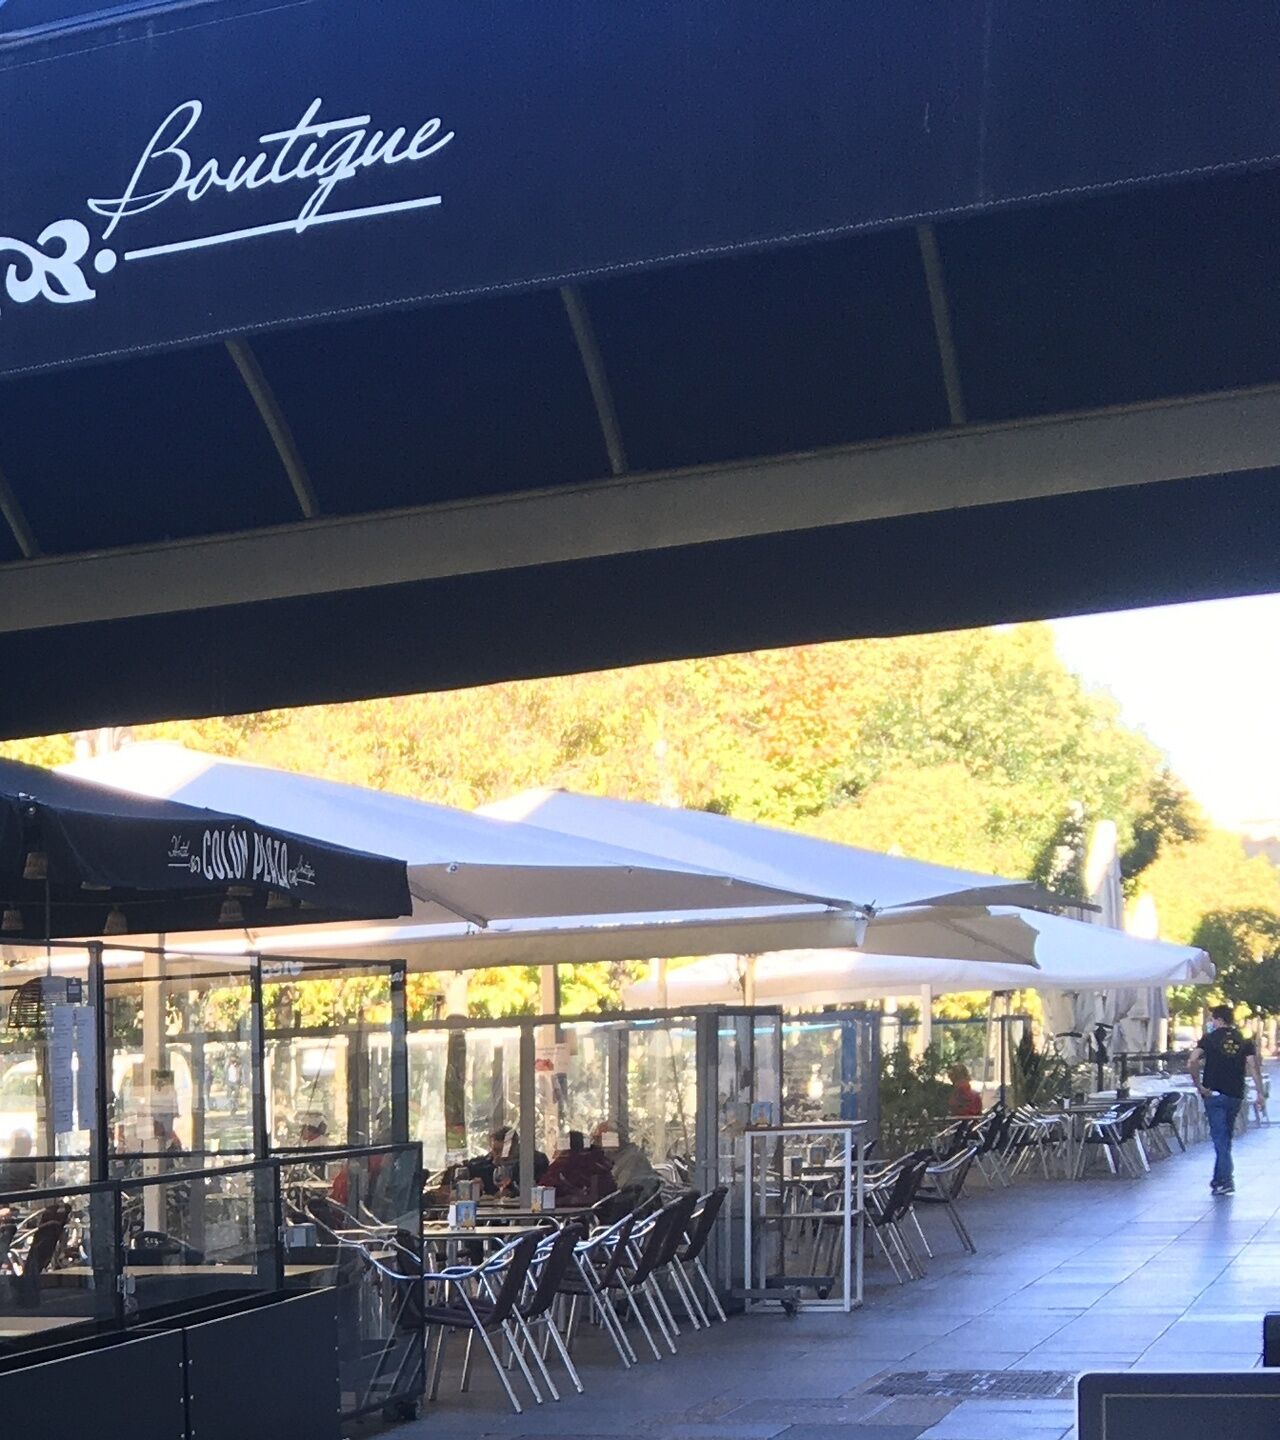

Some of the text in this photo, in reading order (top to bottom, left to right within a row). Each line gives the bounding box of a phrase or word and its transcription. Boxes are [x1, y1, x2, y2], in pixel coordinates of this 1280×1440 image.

[87, 97, 455, 240] Boutique
[202, 824, 249, 880] COLÓN
[252, 831, 291, 889] PLAZA
